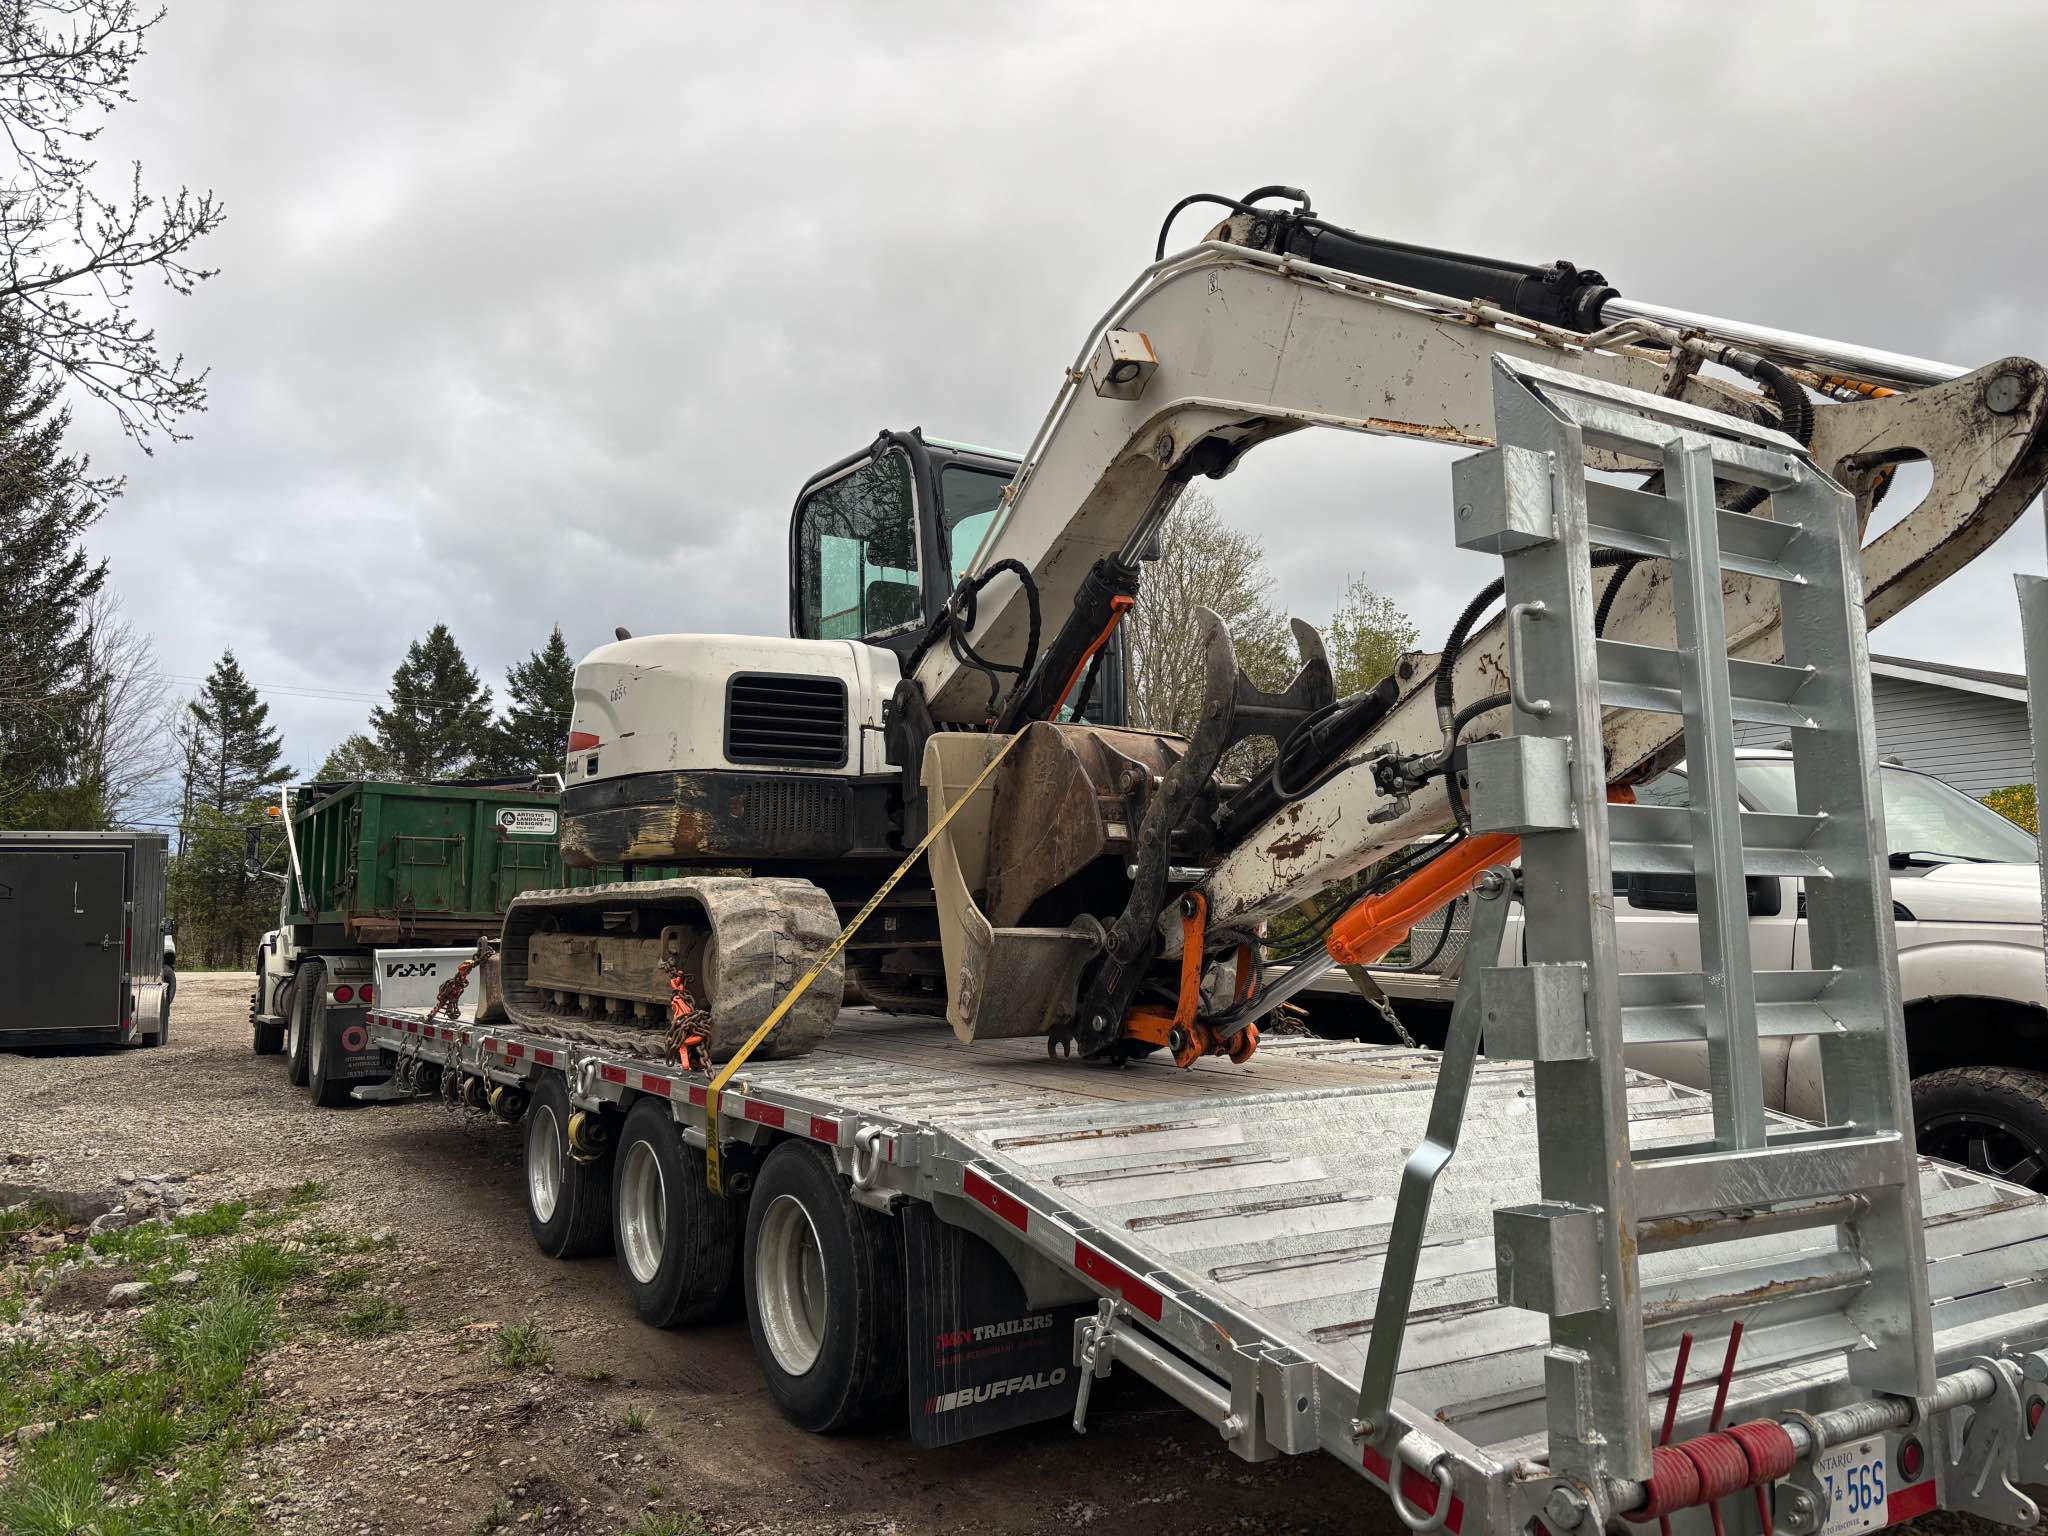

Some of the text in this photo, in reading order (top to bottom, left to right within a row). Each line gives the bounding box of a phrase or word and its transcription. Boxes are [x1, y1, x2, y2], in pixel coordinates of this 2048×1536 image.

[973, 1314, 1053, 1341] TRAILERS
[956, 1367, 1066, 1407] BUFFALO
[1819, 1452, 1853, 1472] NTARIO
[1847, 1460, 1884, 1514] 56S
